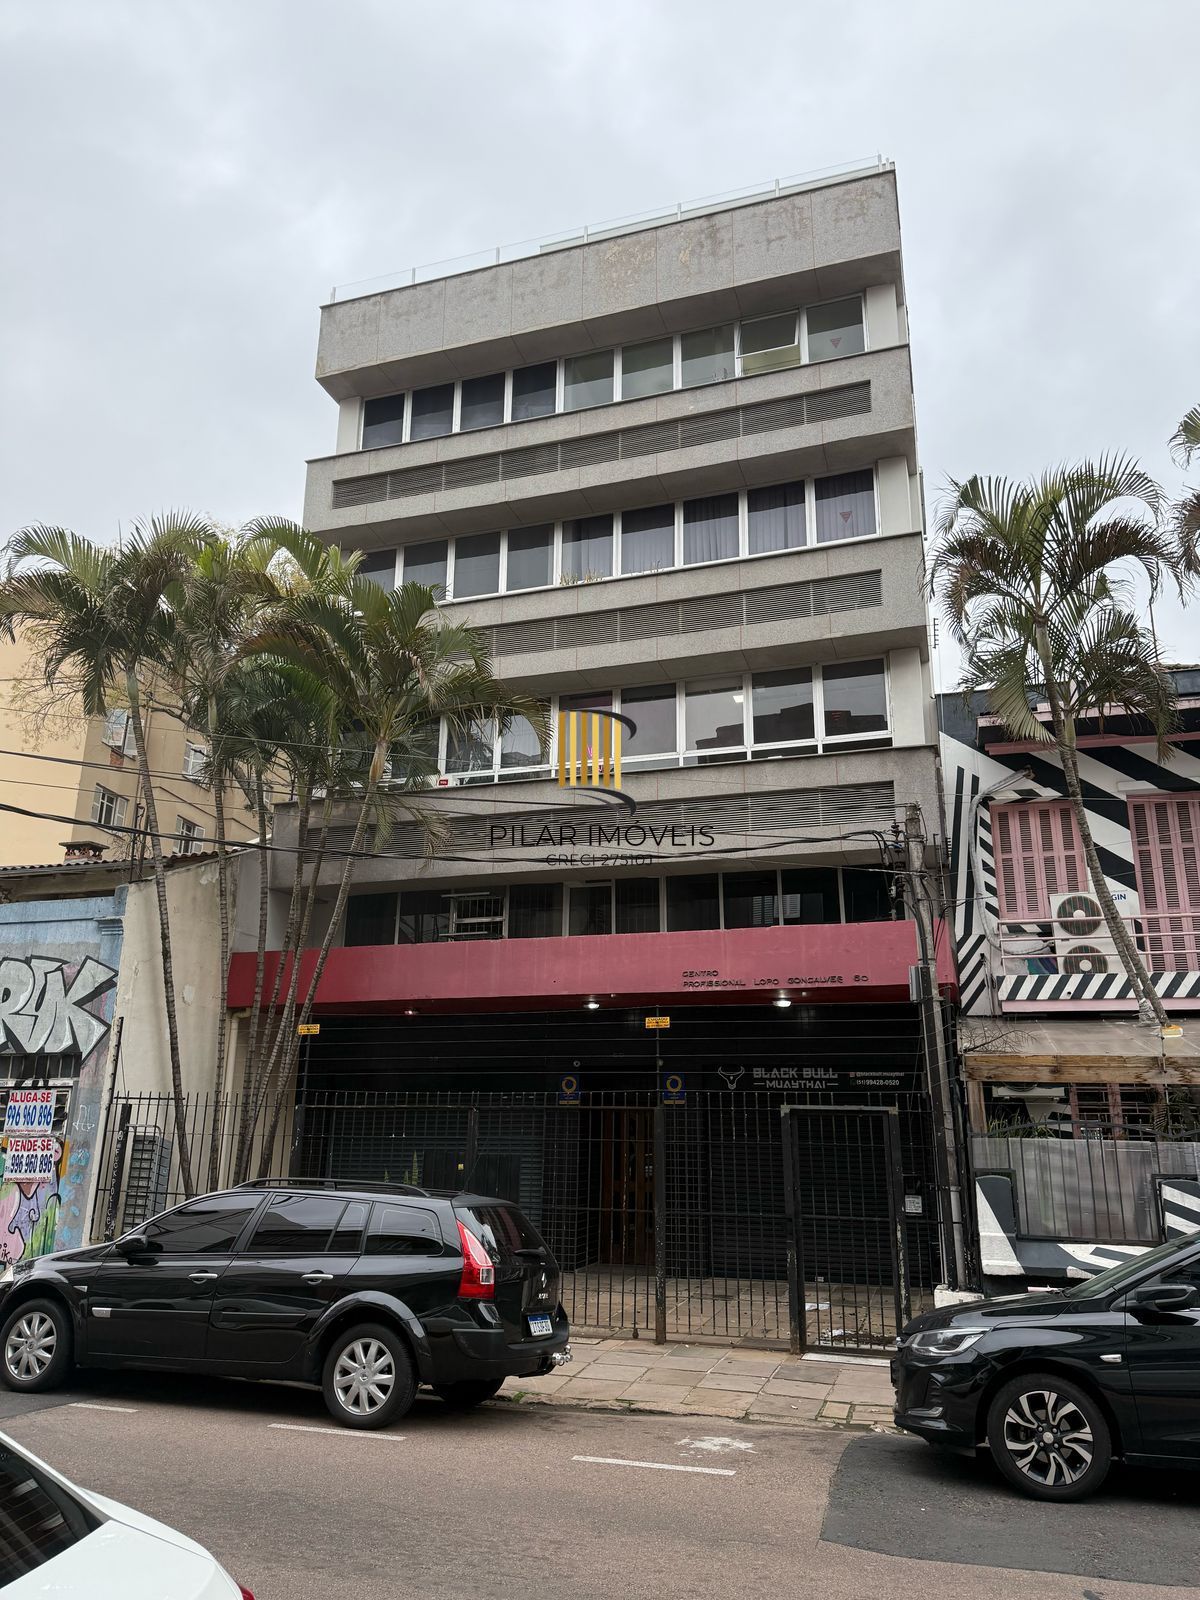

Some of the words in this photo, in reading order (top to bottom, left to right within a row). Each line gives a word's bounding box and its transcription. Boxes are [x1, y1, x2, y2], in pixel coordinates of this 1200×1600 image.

[682, 970, 719, 978] CENTRO
[683, 980, 747, 988] PROFISSIONAL
[753, 978, 780, 986] LOPO
[753, 1067, 799, 1079] BLACK
[802, 1067, 839, 1079] BULL
[766, 1080, 826, 1089] MUAYTHAI
[10, 1092, 52, 1103] ALUGA-SE
[6, 1105, 21, 1126] 996
[23, 1105, 37, 1126] 960
[38, 1105, 53, 1126] 896
[10, 1139, 52, 1152] VENDE-SE
[11, 1153, 24, 1173] 996
[25, 1153, 38, 1173] 960
[39, 1153, 53, 1173] 896
